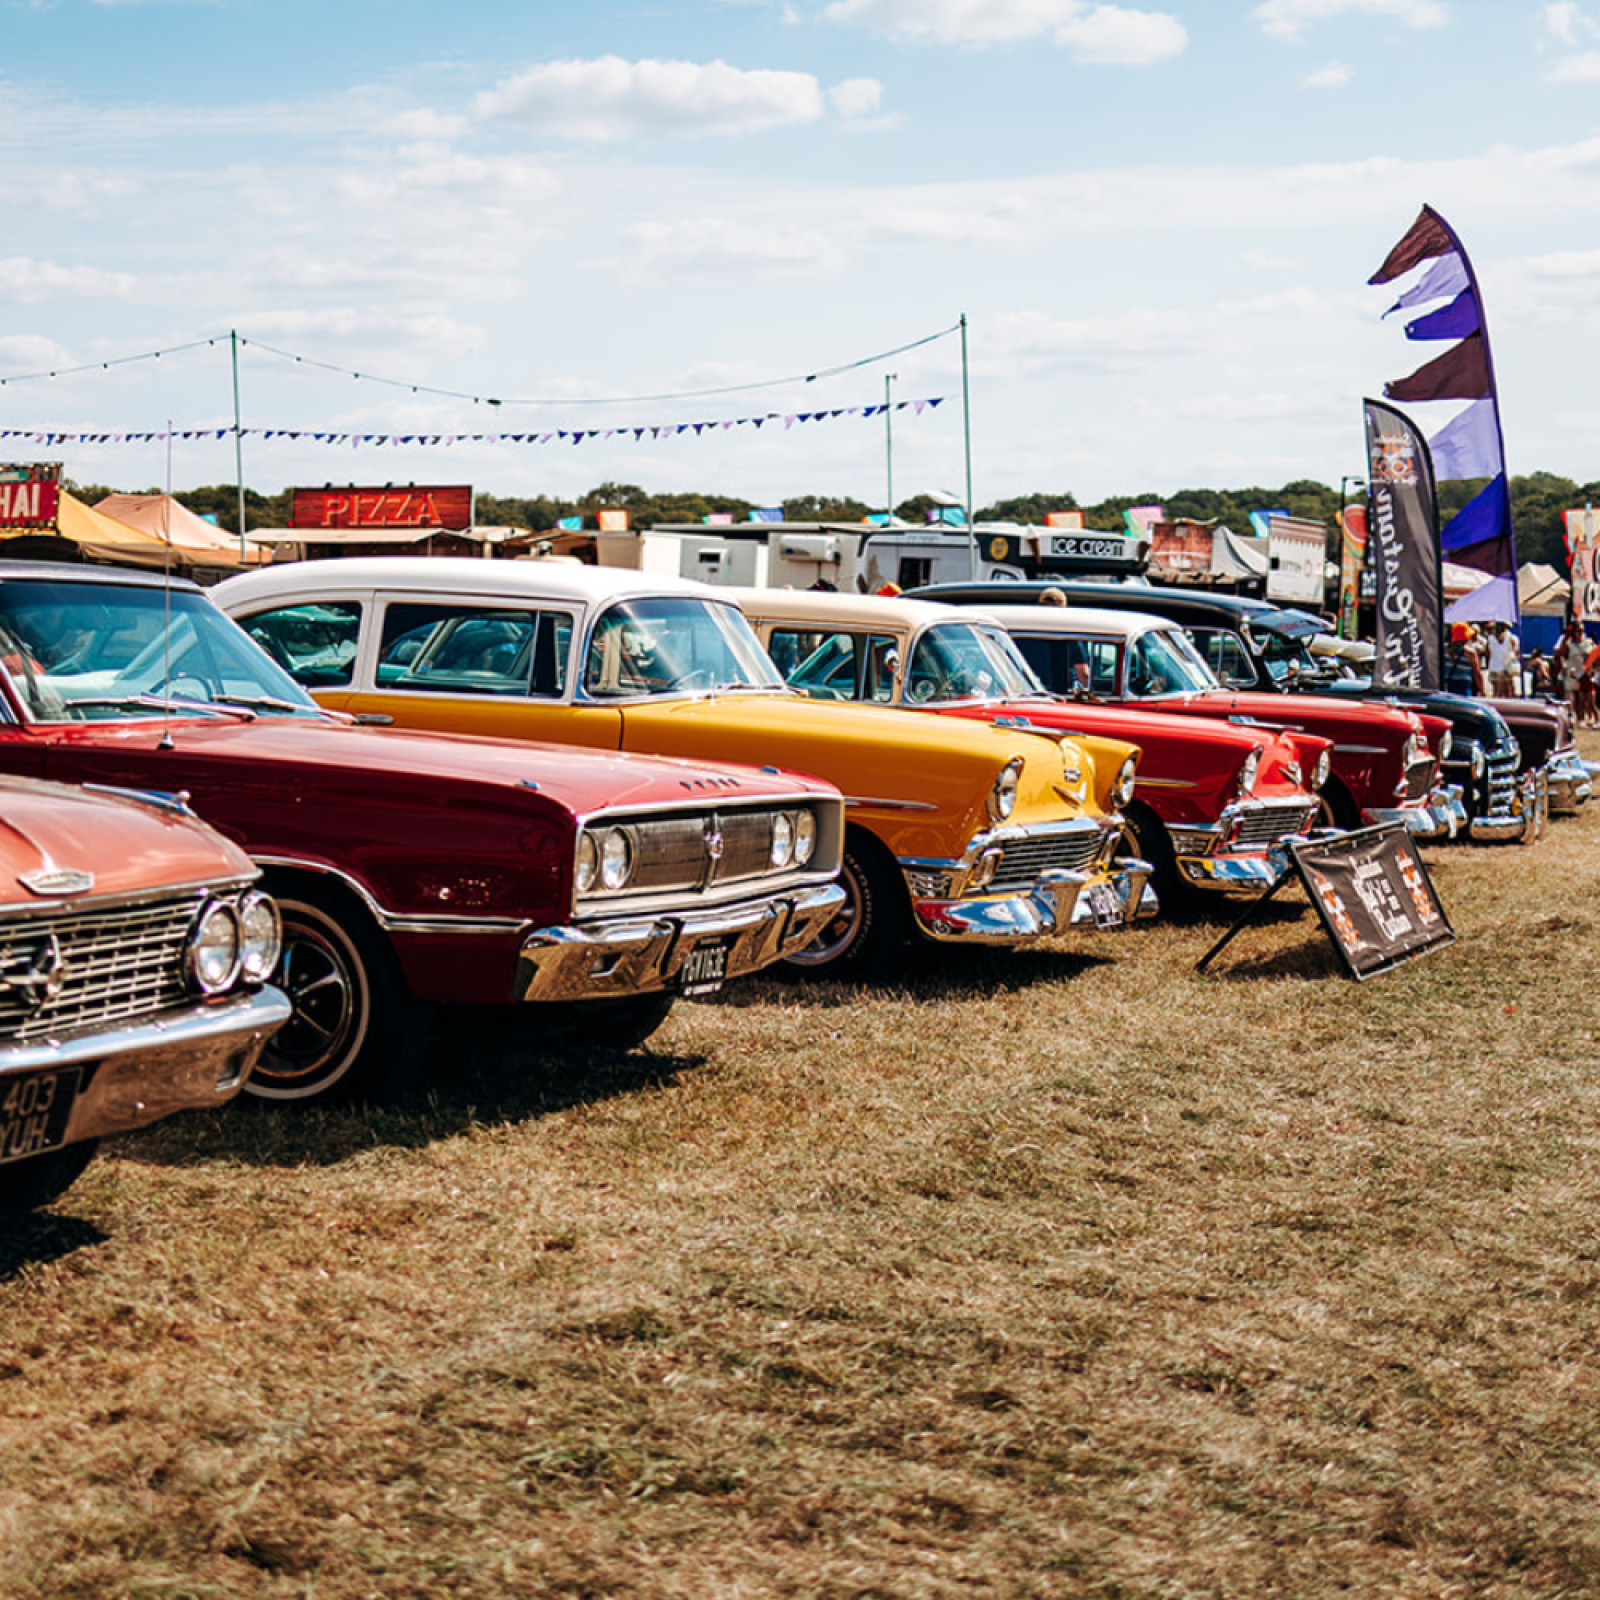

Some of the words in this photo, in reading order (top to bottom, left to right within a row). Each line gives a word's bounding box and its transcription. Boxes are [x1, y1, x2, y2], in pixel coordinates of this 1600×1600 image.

[320, 492, 443, 526] PIZZA
[2, 1074, 57, 1119] 403
[0, 1112, 49, 1158] YUH
